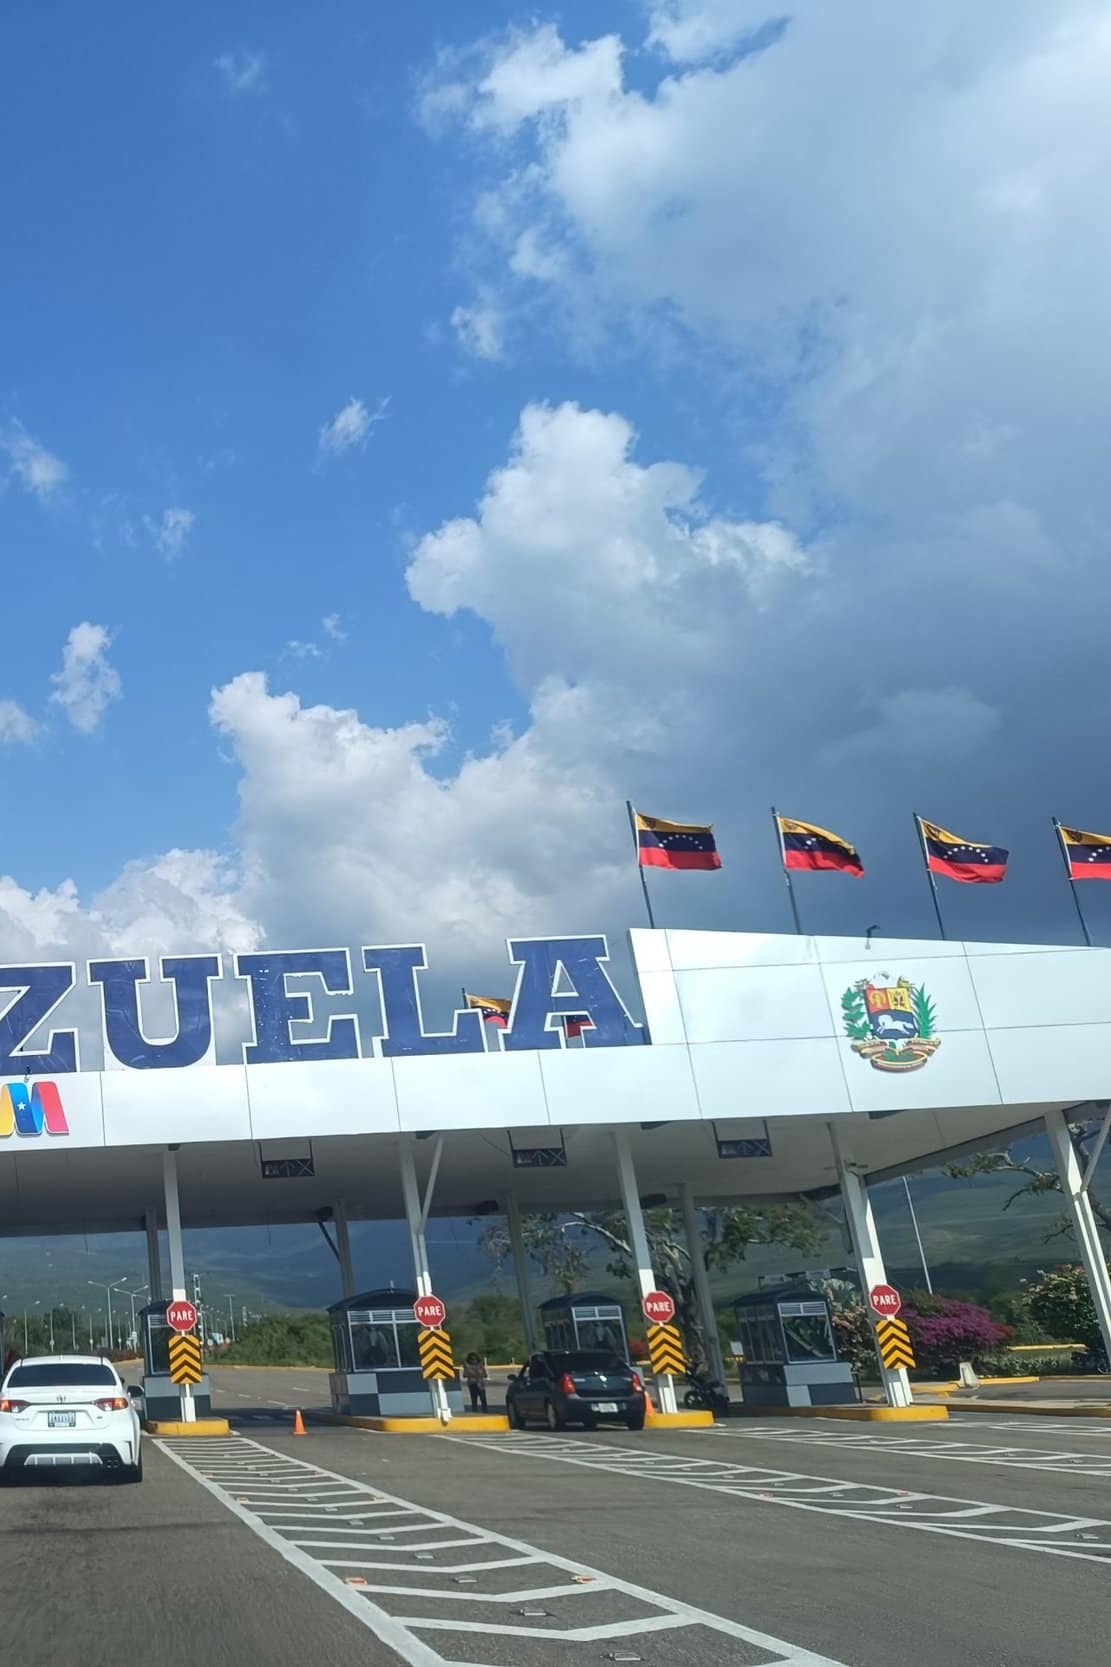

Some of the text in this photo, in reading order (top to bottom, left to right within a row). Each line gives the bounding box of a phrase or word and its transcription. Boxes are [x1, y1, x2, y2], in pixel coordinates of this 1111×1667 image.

[872, 1294, 897, 1306] PARE
[417, 1305, 442, 1317] PARE
[646, 1301, 672, 1313] PARE
[170, 1310, 194, 1322] PARE
